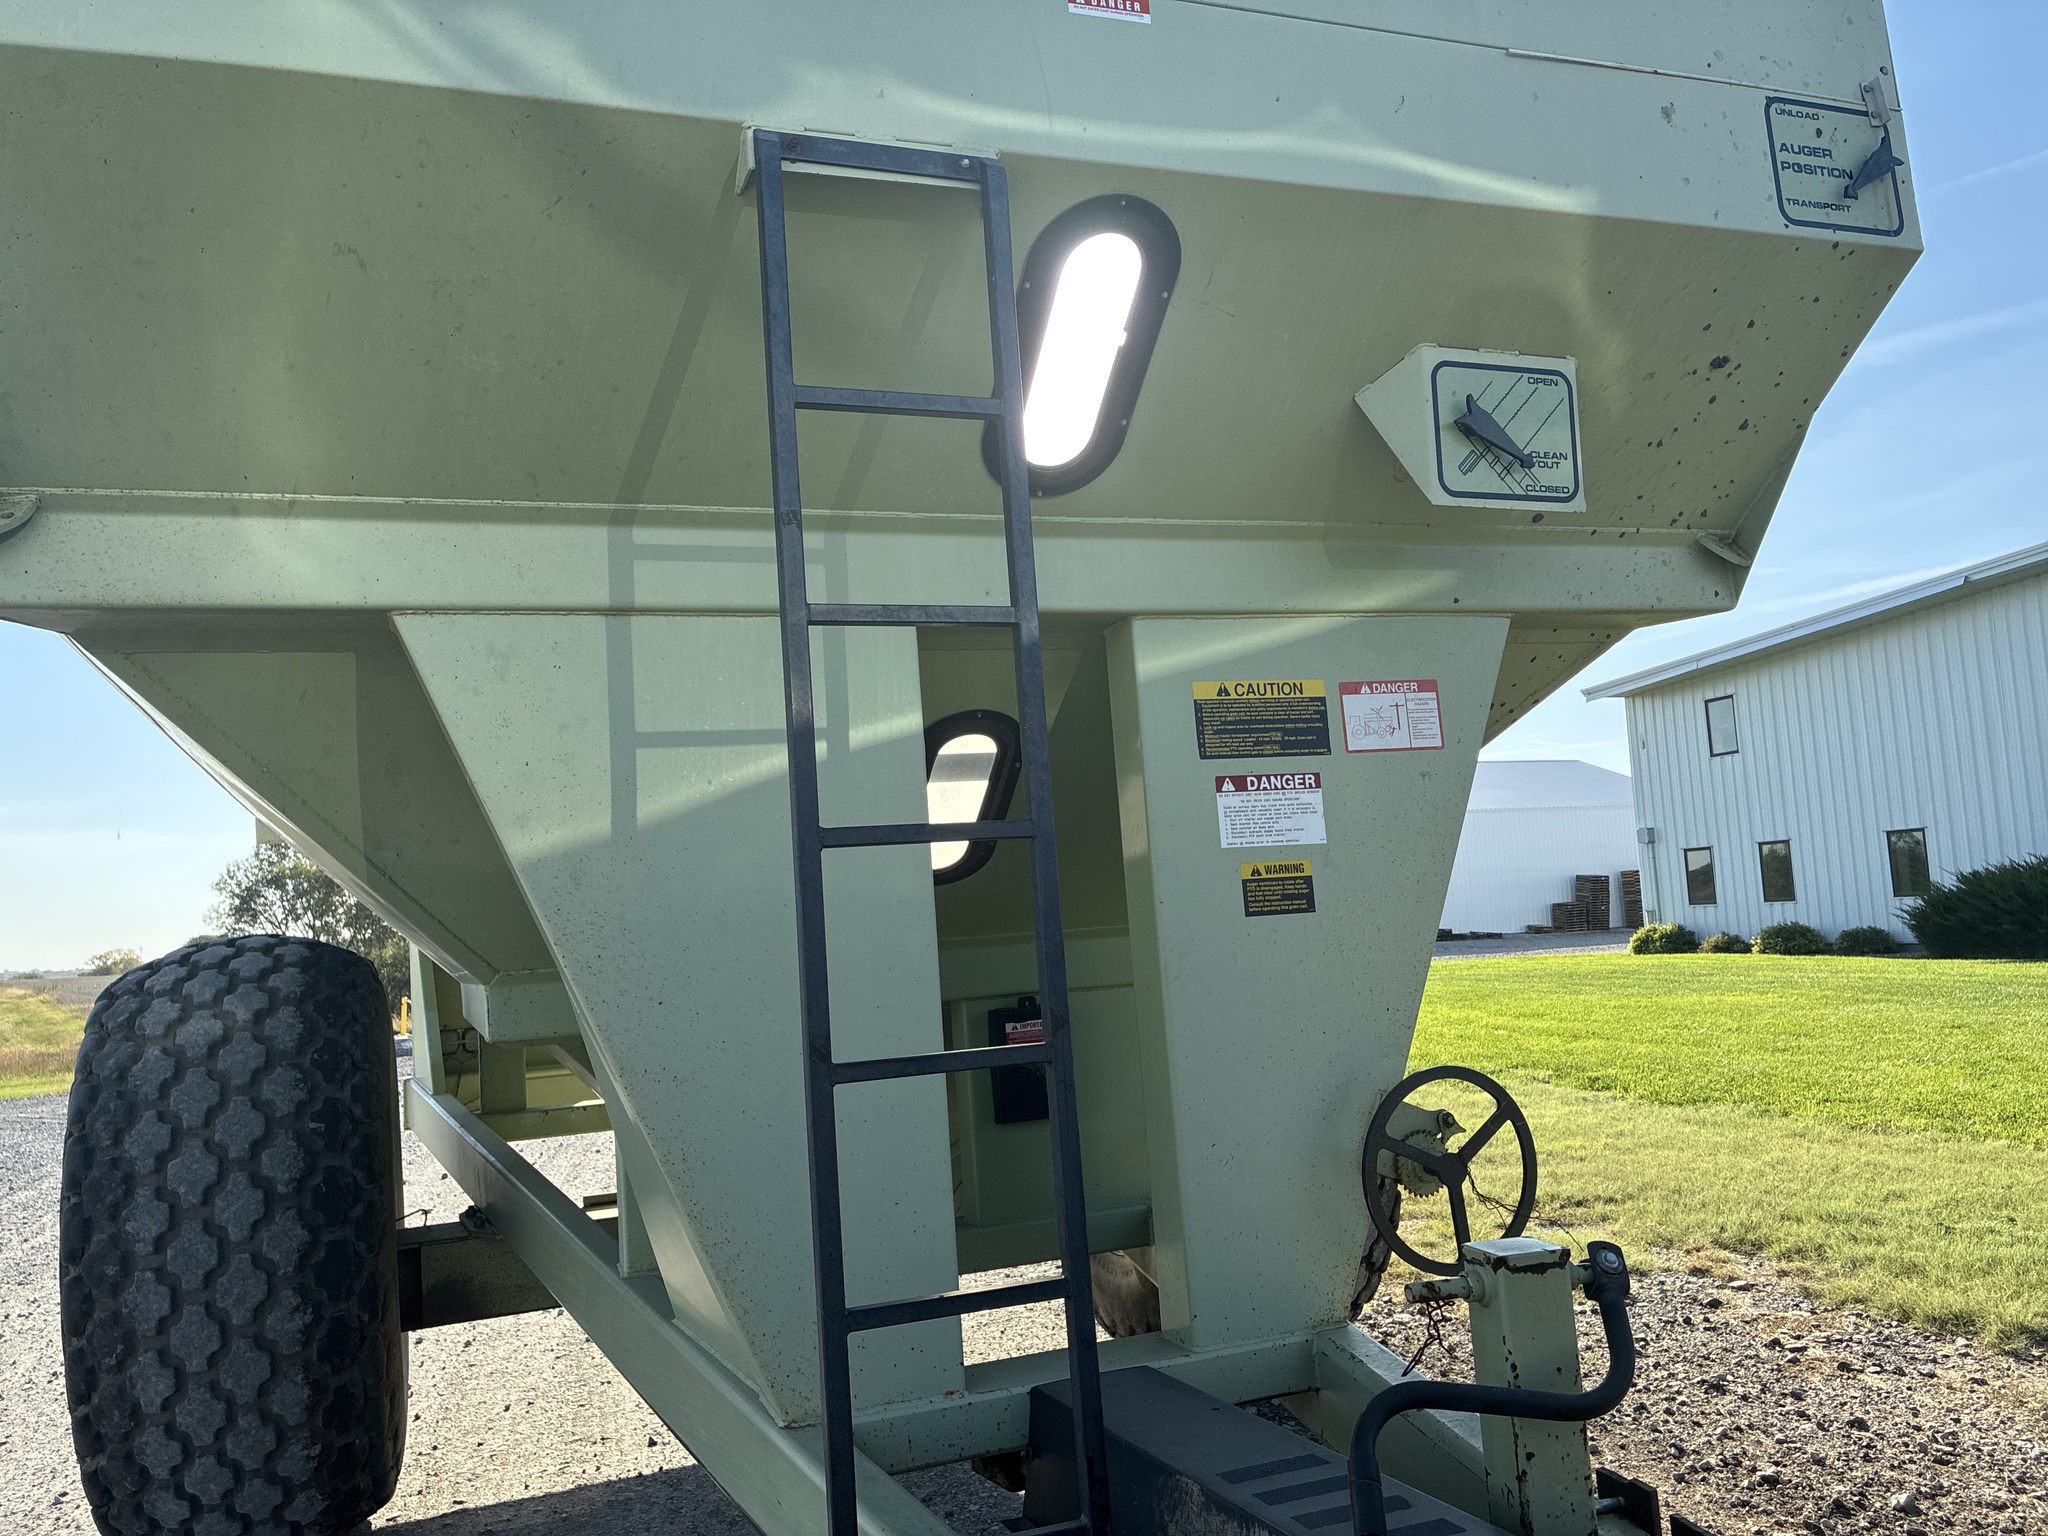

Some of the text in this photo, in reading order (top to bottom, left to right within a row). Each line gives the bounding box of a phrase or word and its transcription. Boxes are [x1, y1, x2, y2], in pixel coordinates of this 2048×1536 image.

[1775, 108, 1820, 120] UNLOAD
[1779, 142, 1832, 160] AUGER
[1780, 160, 1854, 180] POSITION
[1785, 198, 1852, 212] TRANSPORT
[1527, 376, 1558, 386] OPEN
[1530, 450, 1568, 460] CLEAN
[1537, 460, 1561, 469] OUT
[1526, 484, 1570, 494] CLOSED
[1234, 682, 1304, 696] CAUTION
[1372, 682, 1418, 693] DANGER
[1246, 774, 1316, 790] DANGER
[1264, 863, 1304, 875] WARNING
